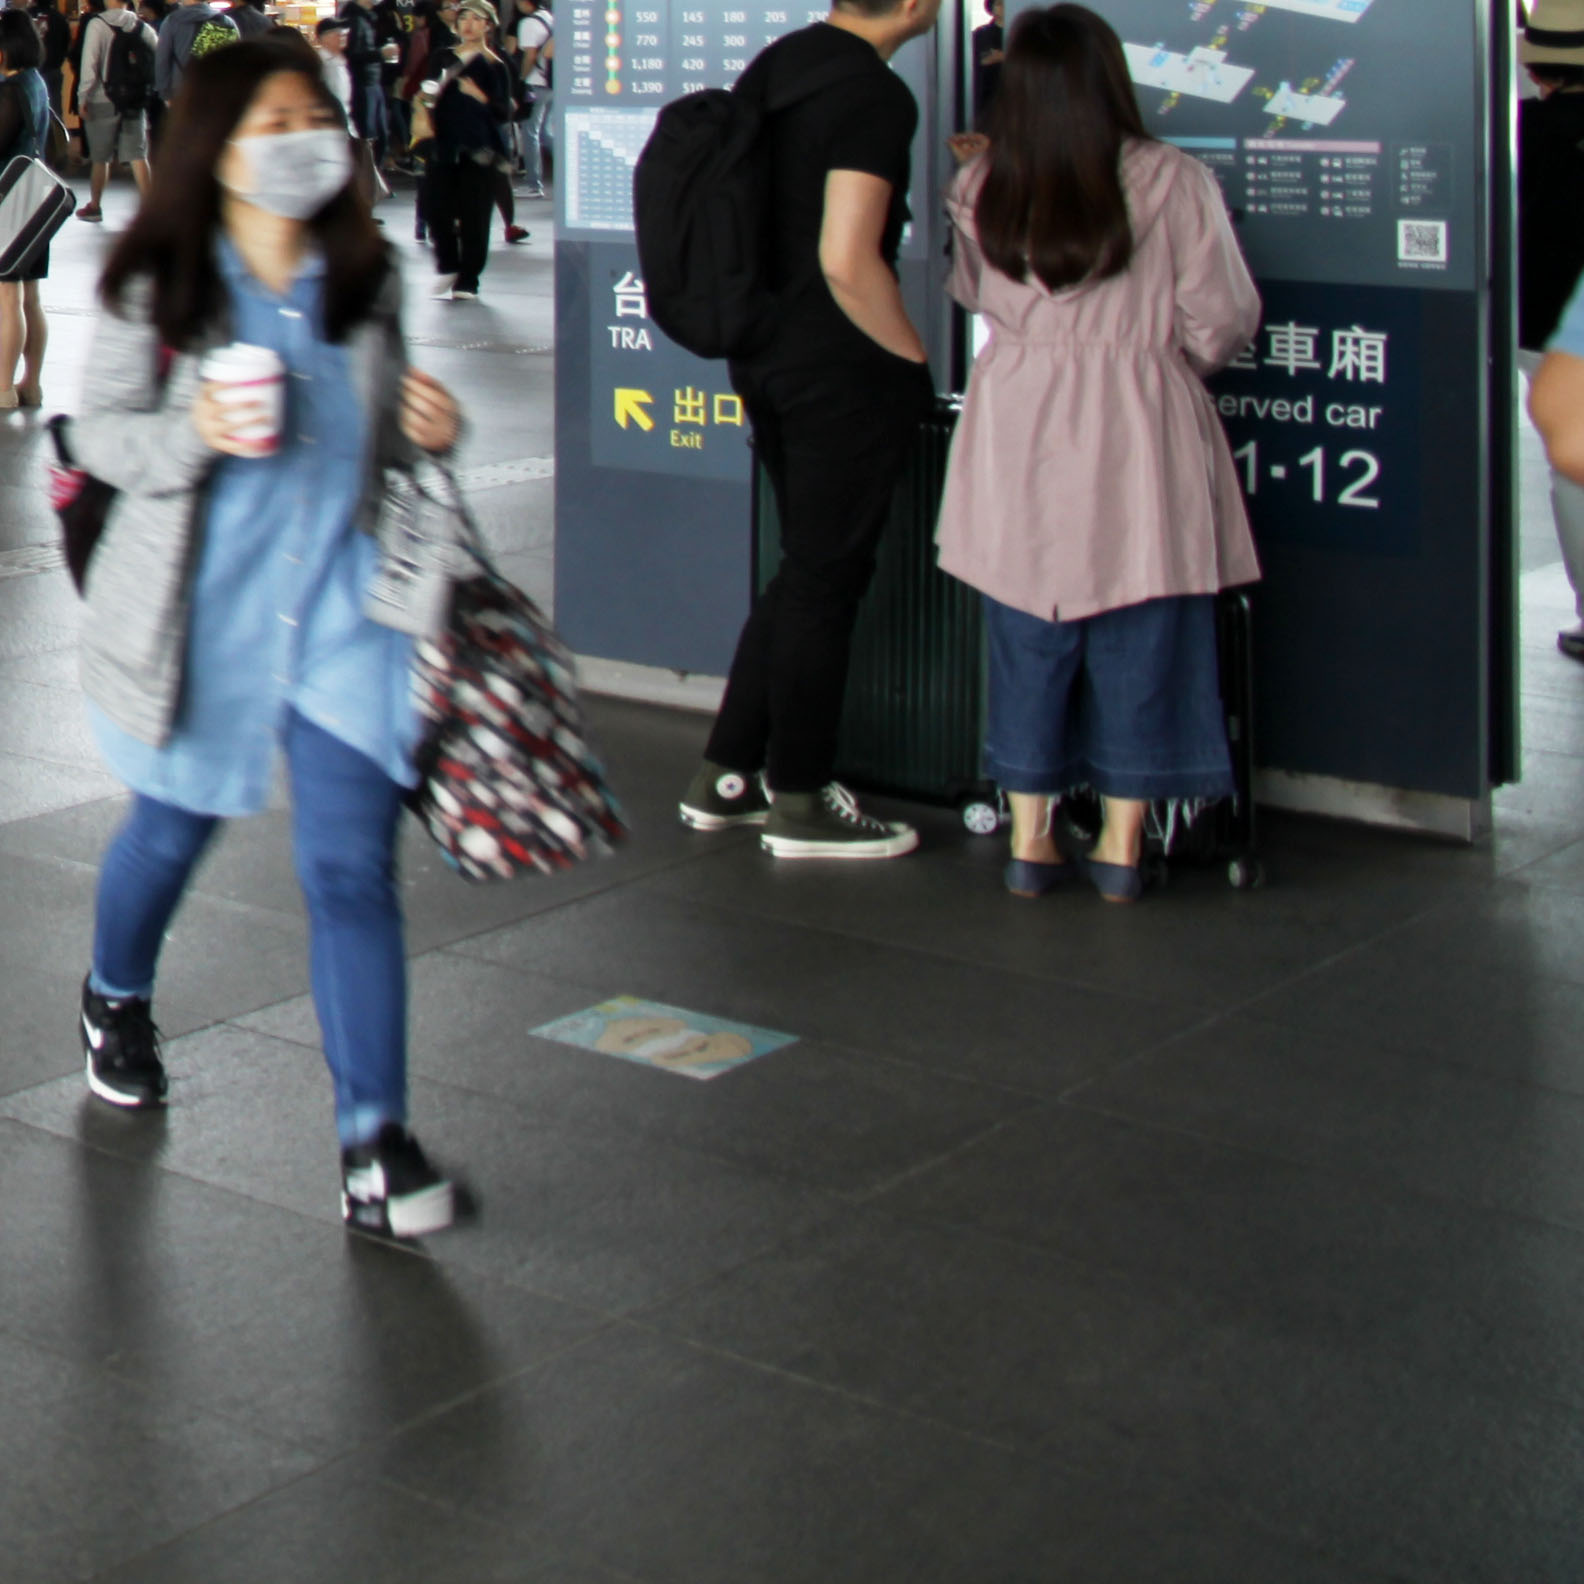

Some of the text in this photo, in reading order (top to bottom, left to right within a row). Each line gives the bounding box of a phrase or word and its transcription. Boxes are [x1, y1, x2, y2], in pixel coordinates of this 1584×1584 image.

[608, 326, 652, 351] TRA
[673, 386, 743, 426] 出口
[1325, 402, 1383, 429] car
[670, 429, 703, 450] Exit
